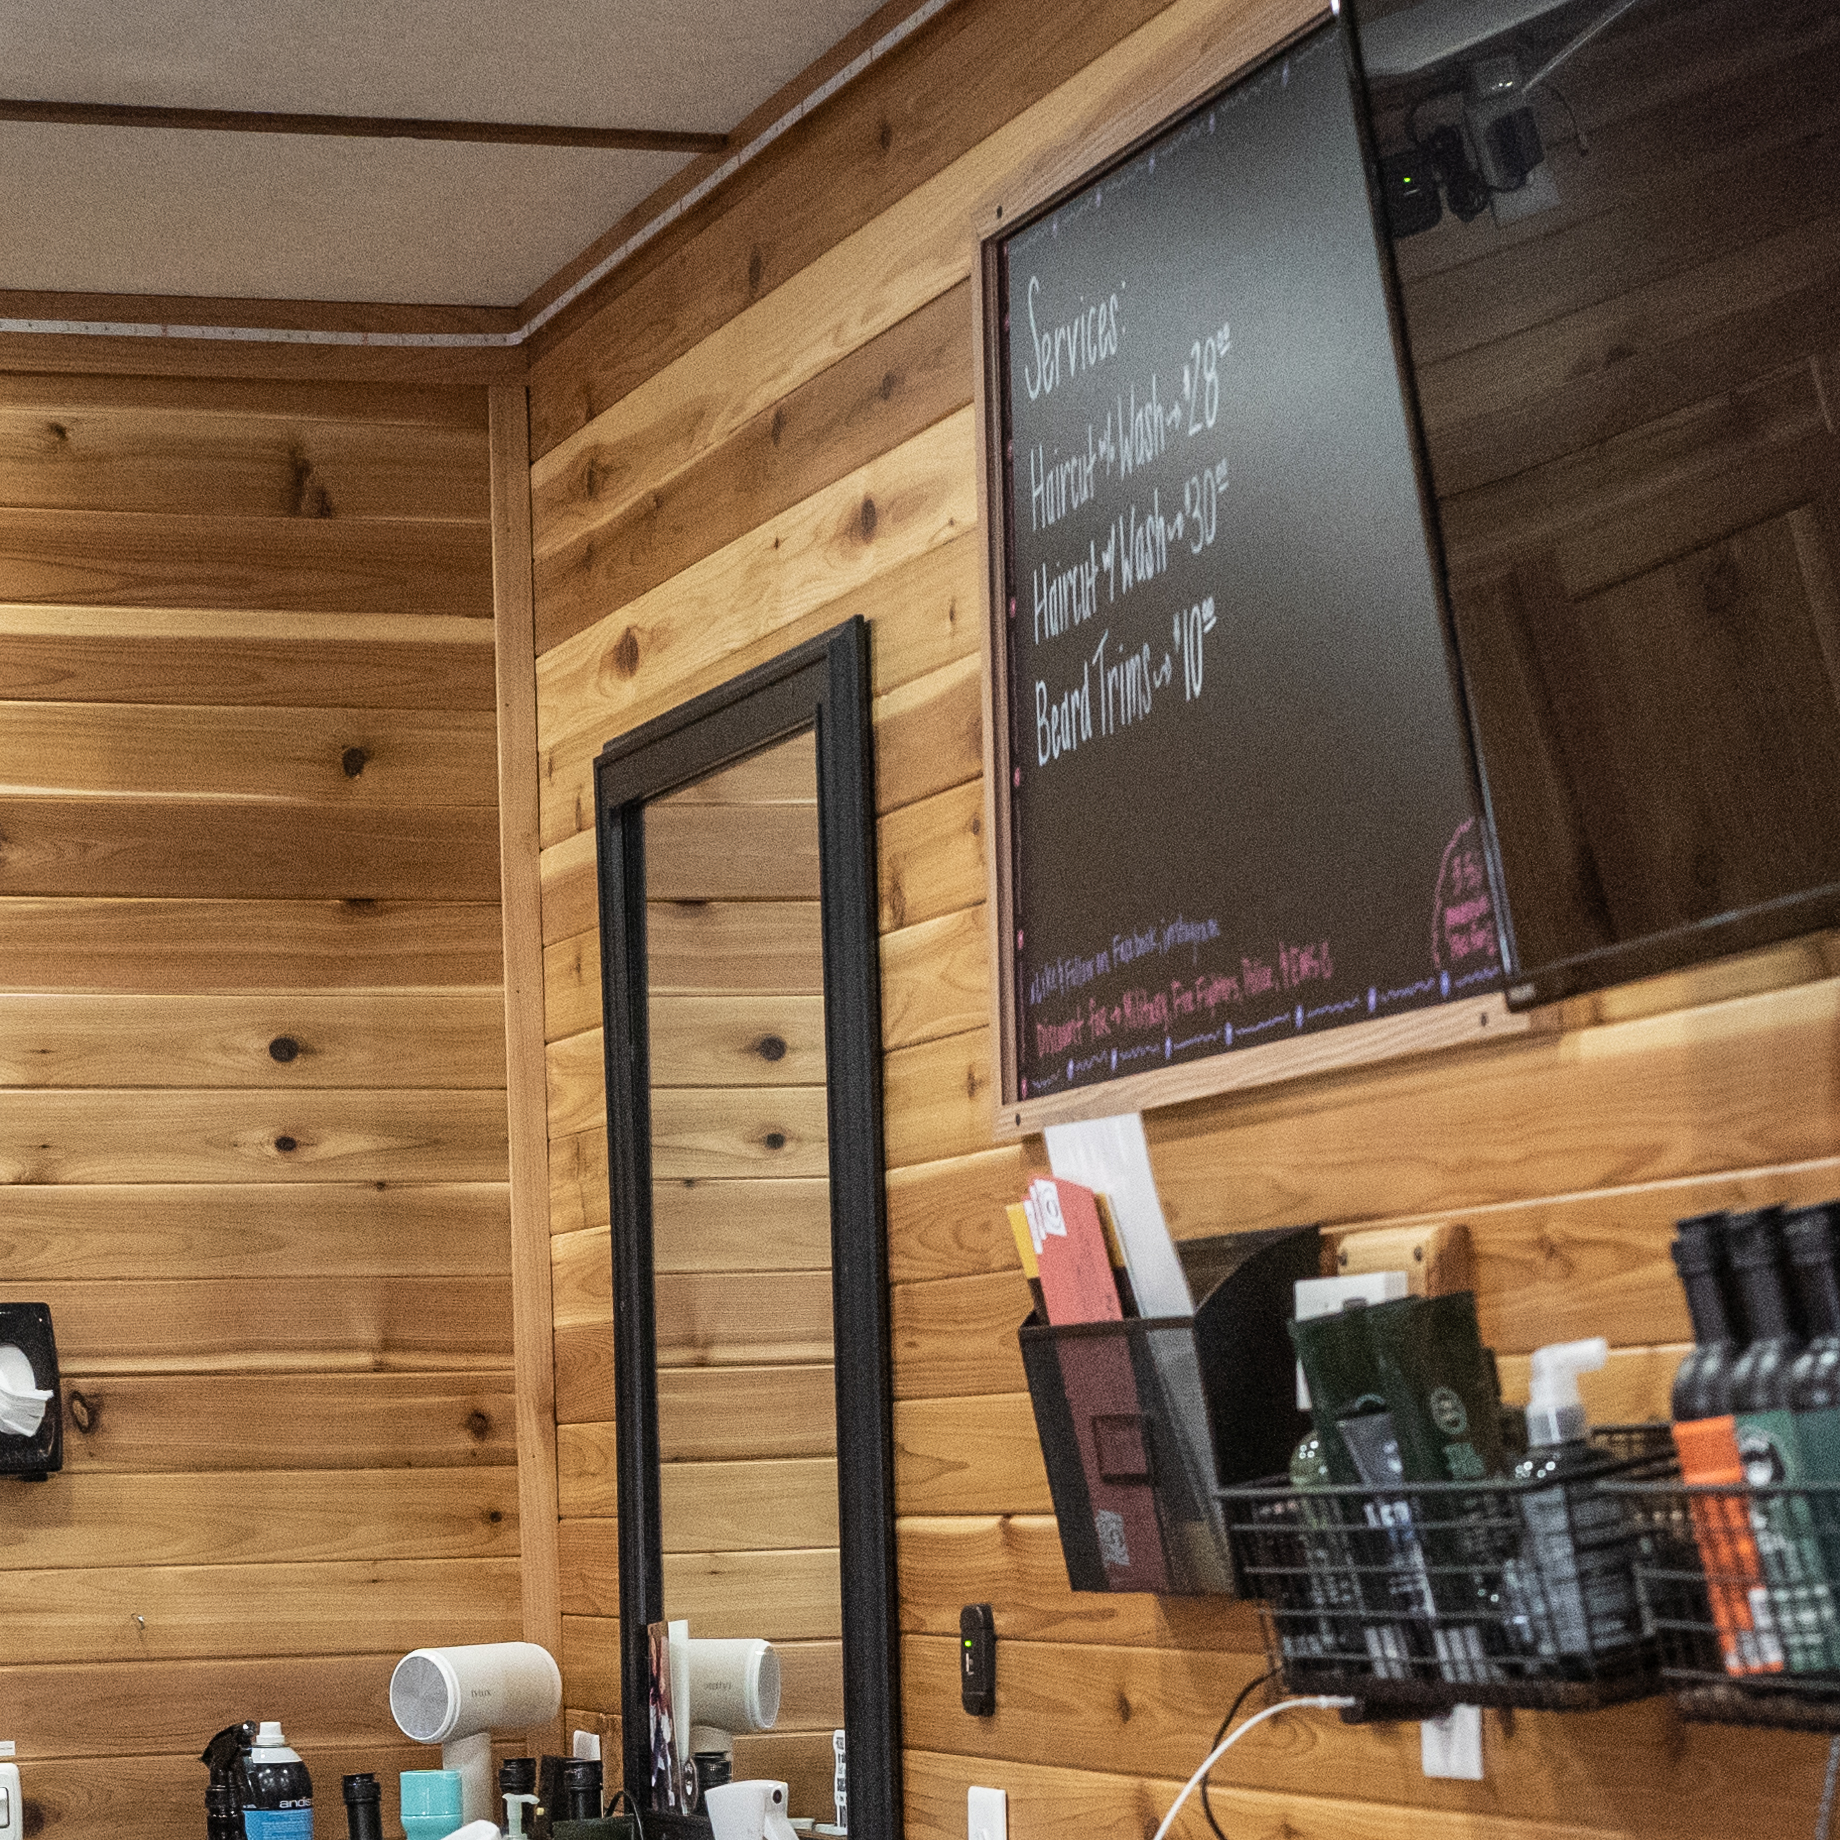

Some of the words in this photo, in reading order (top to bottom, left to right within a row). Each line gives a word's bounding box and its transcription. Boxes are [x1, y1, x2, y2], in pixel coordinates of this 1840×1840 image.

[1025, 275, 1127, 400] Services:
[1030, 424, 1098, 532] Haircut
[1118, 372, 1166, 482] Wash
[1033, 539, 1100, 645] Haircut
[1119, 487, 1168, 595] Wash
[1034, 661, 1094, 767] Beard
[1092, 628, 1153, 736] Trims
